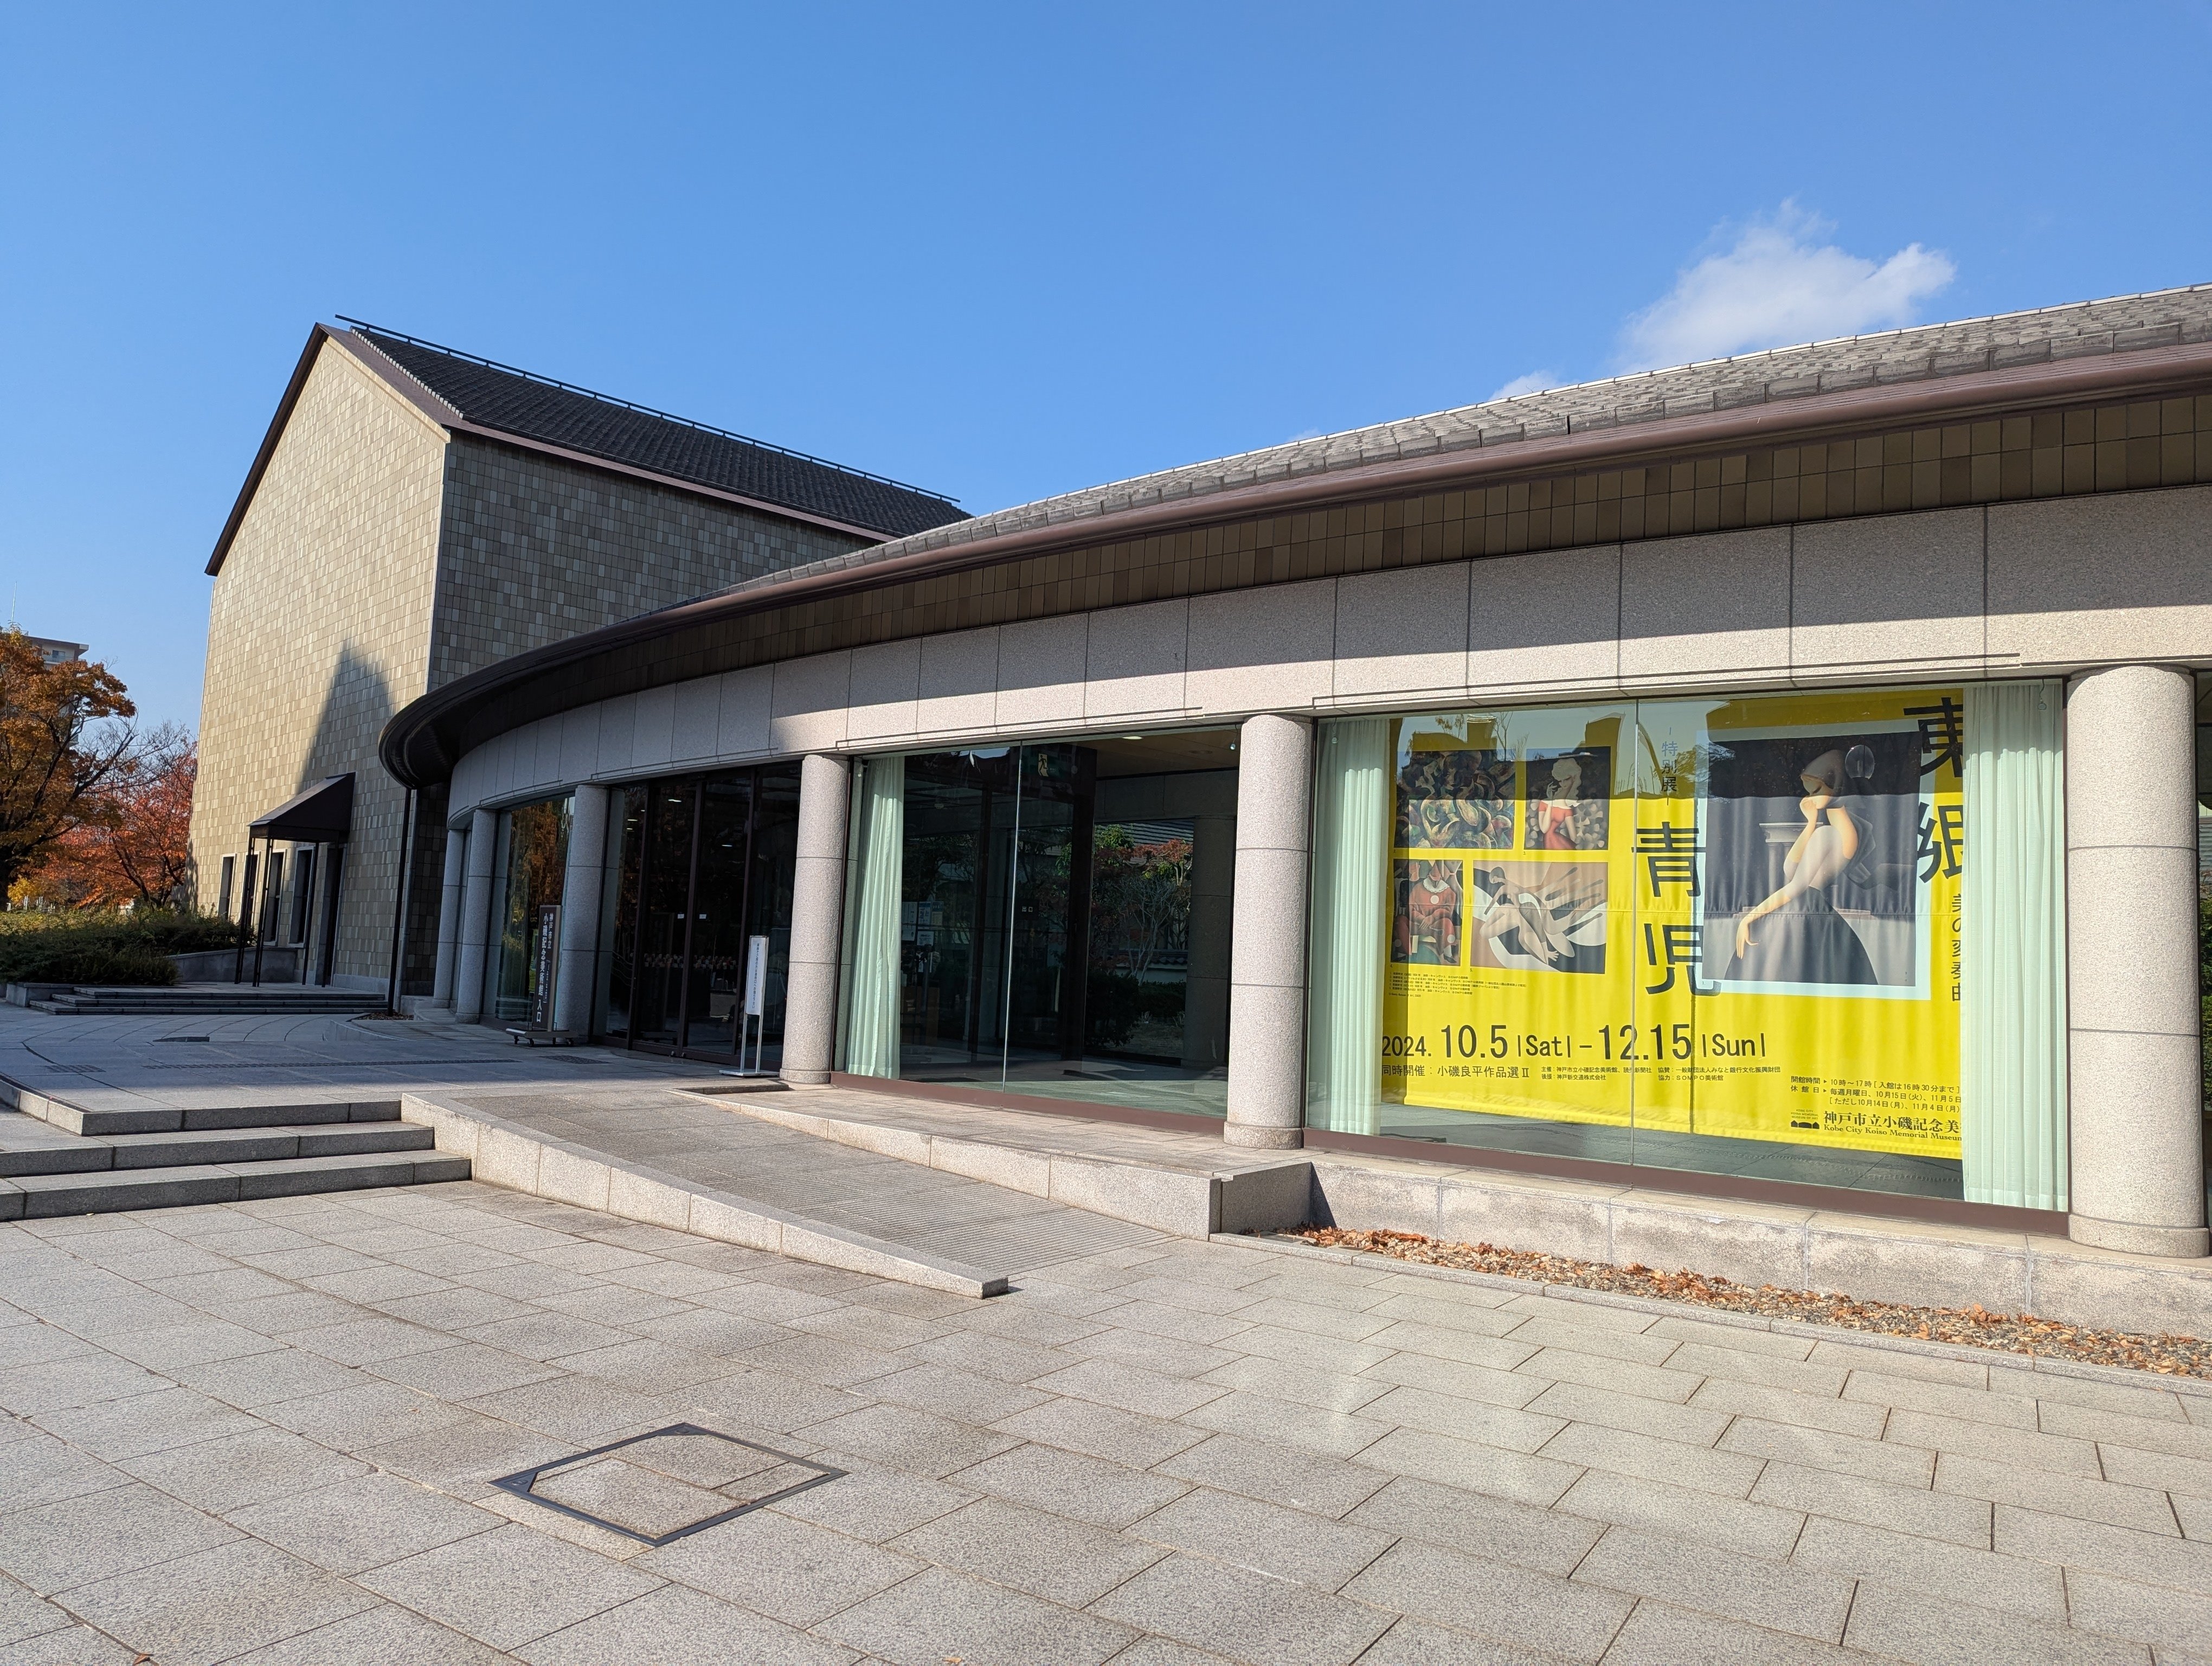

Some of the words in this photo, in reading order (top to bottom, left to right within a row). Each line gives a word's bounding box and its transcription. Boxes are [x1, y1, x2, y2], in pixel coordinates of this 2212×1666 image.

[1661, 741, 1678, 792] 特別展
[1631, 821, 1722, 996] 青児
[536, 999, 542, 1022] 入口
[1823, 1111, 1962, 1134] 神戸市立小磯記念美
[1846, 1126, 1862, 1134] City
[1889, 1129, 1928, 1138] Memorial
